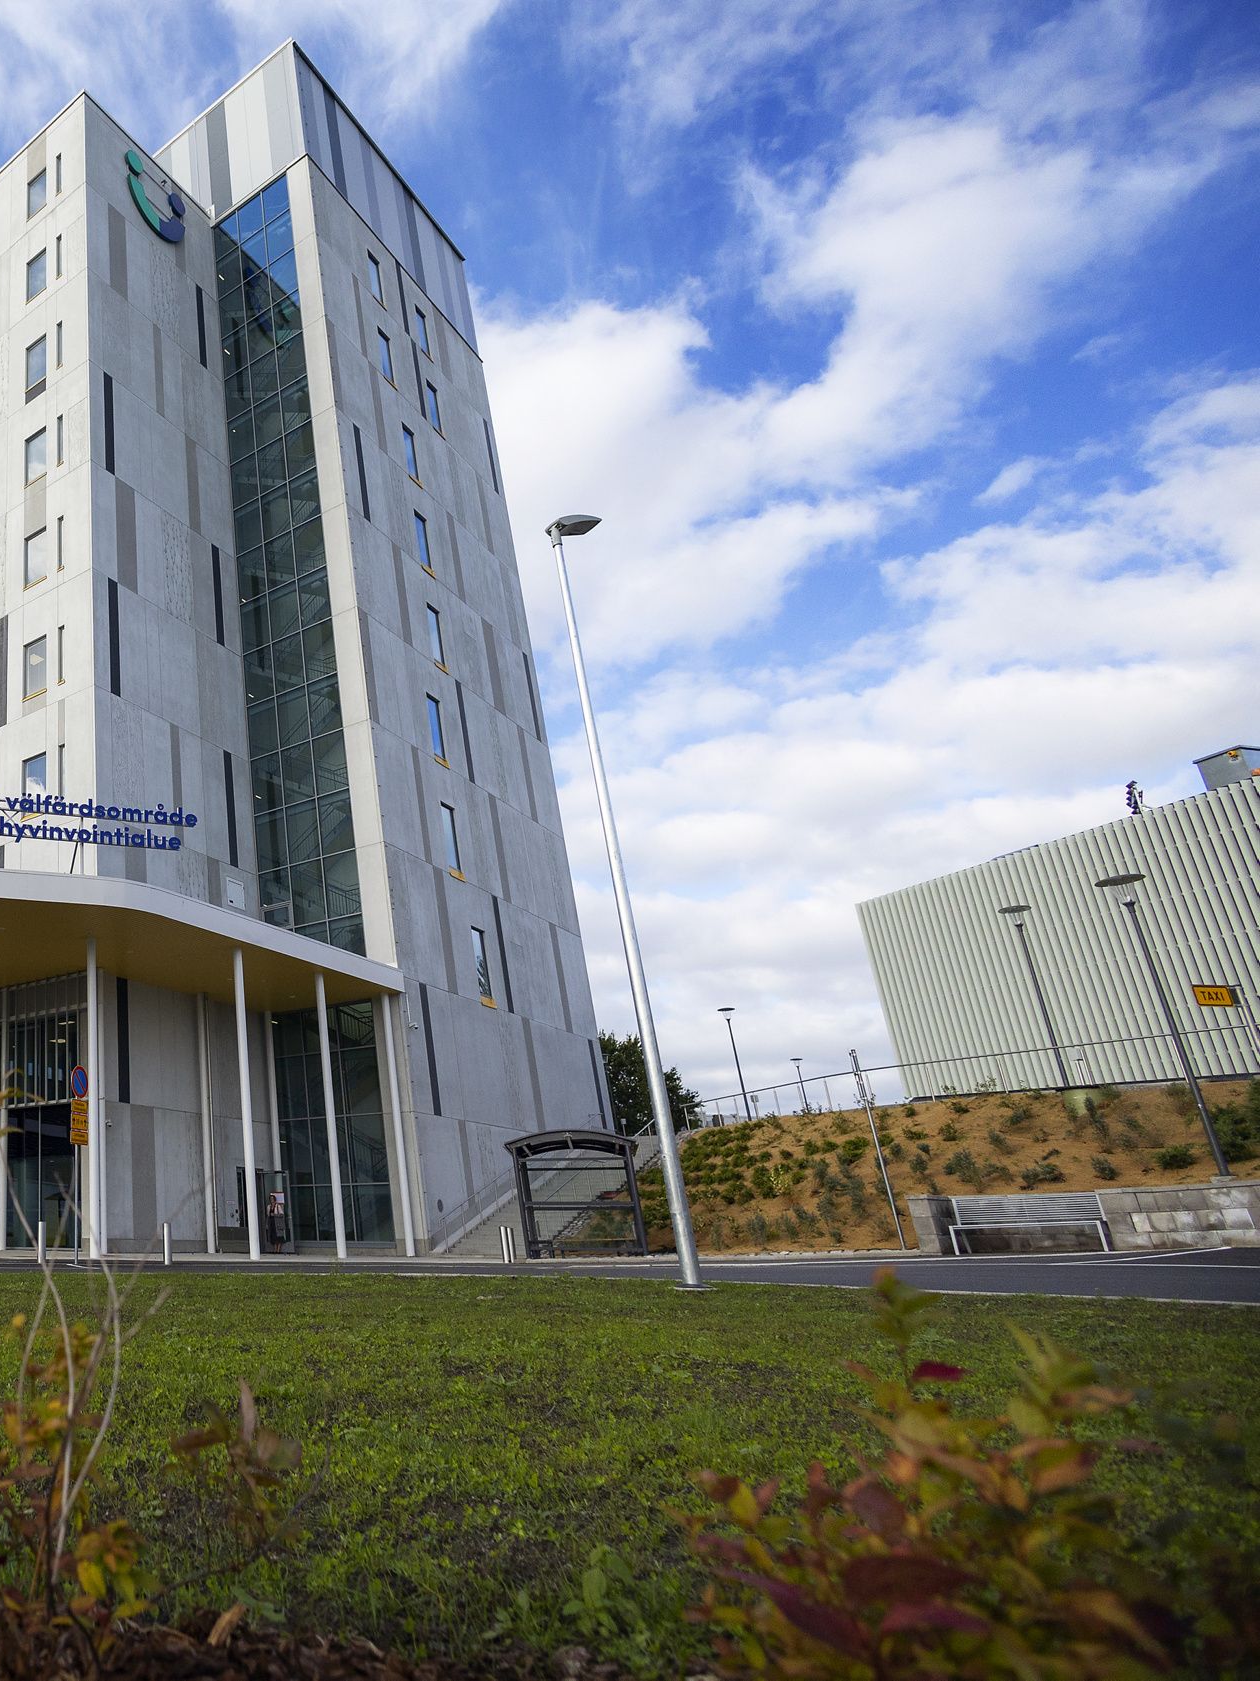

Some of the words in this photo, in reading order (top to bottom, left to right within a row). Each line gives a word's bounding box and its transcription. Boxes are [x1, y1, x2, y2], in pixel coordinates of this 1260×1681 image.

[5, 792, 198, 827] välfärdsområde
[0, 816, 181, 850] hyvinvointialue
[1200, 991, 1225, 1001] TAXI
